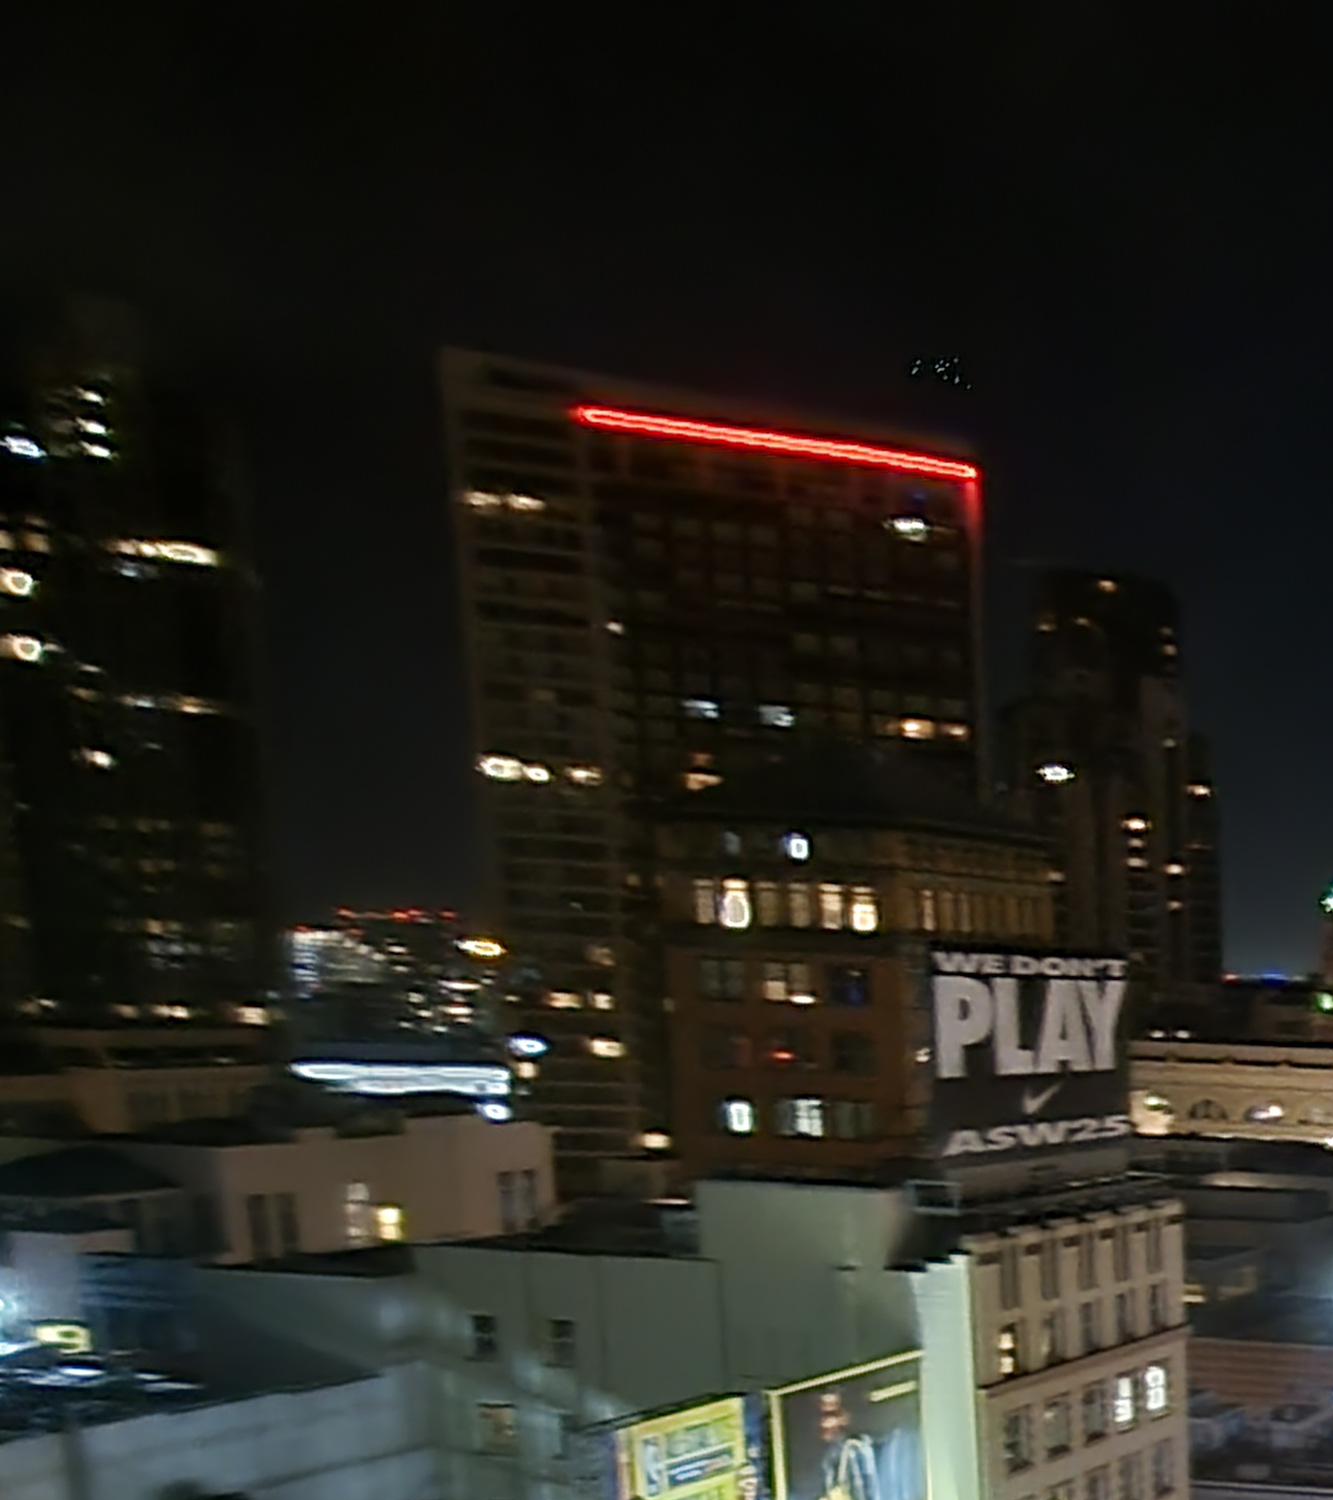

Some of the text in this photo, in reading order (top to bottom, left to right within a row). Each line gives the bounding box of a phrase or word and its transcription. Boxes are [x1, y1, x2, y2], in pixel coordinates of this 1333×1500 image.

[932, 951, 1004, 975] WE
[934, 975, 1127, 1079] PLAY
[942, 1115, 1132, 1157] ASW25
